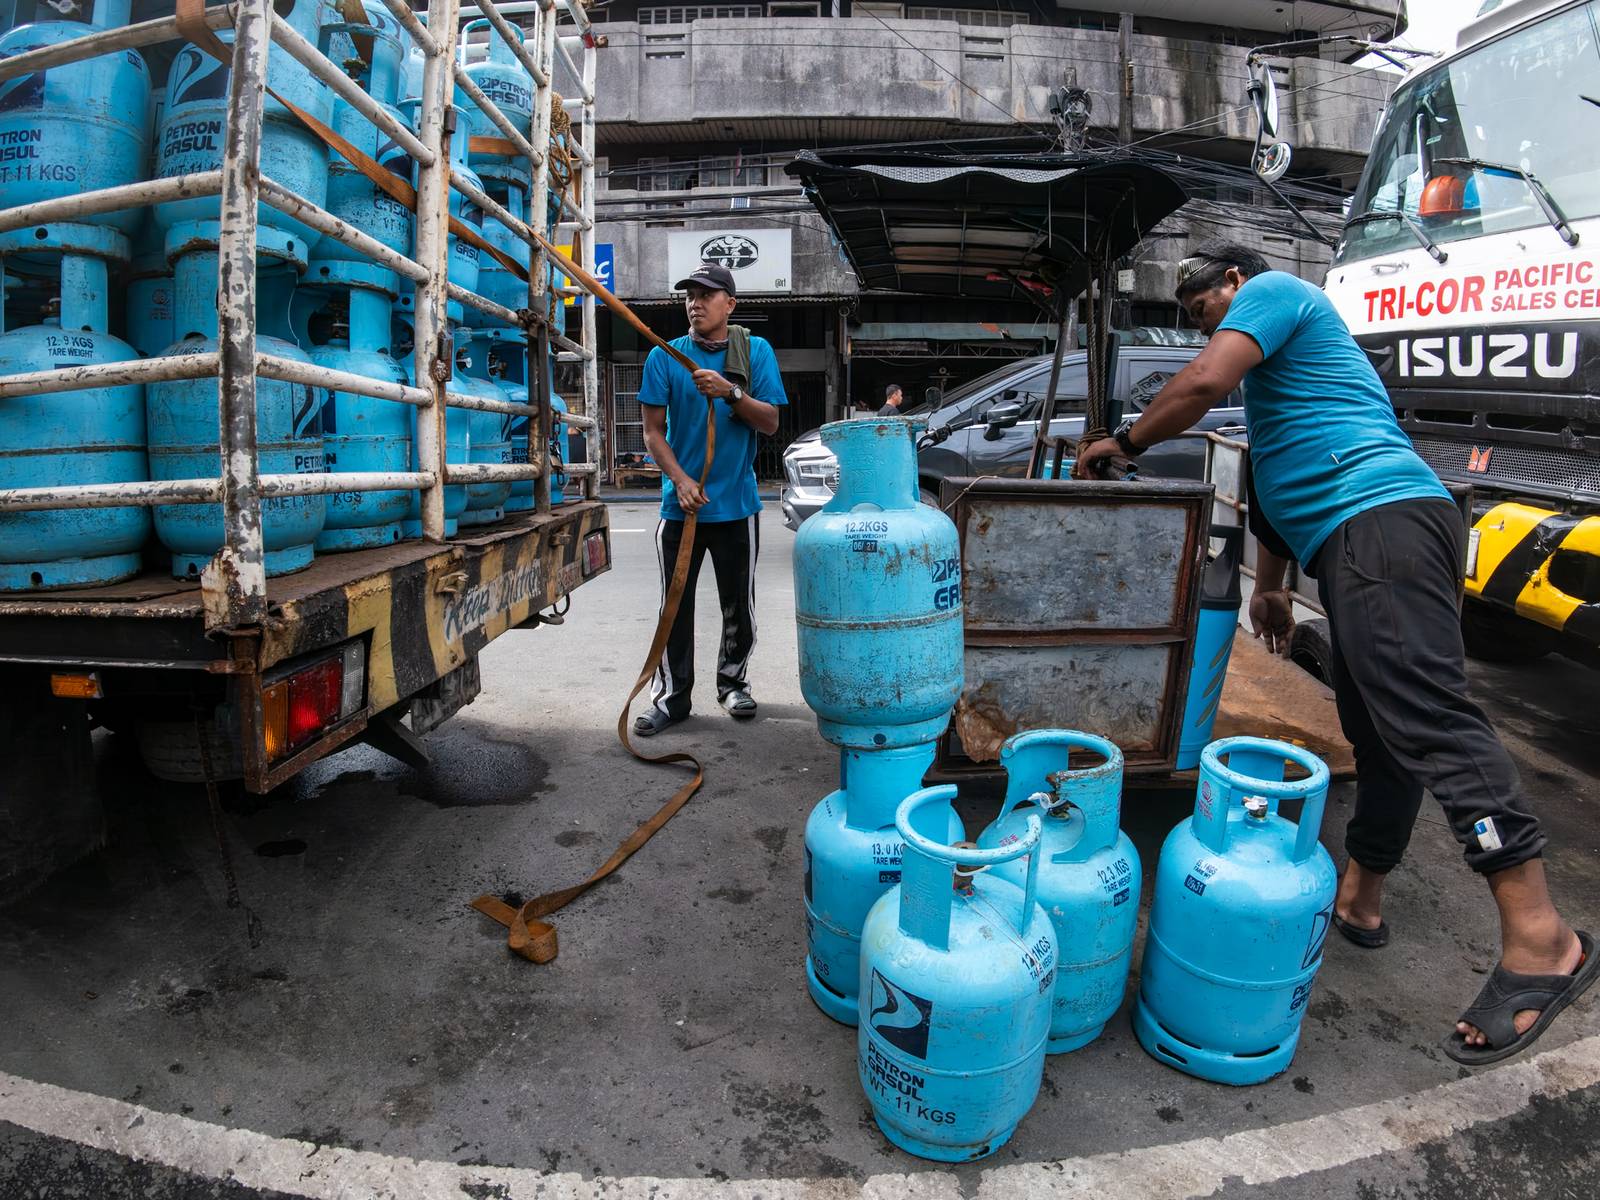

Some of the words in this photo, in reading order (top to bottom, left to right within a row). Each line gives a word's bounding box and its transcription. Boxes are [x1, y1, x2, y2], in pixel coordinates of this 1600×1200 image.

[166, 121, 222, 143] PETRON
[164, 135, 218, 160] GASUL
[40, 164, 77, 182] KGS
[1494, 261, 1594, 291] PACIFIC
[1364, 275, 1486, 323] TRI-COR
[1491, 291, 1557, 313] SALES
[48, 347, 67, 357] TARE
[67, 348, 94, 359] WEIGHT
[1398, 332, 1578, 378] ISUZU
[873, 856, 888, 865] TARE
[868, 1040, 926, 1089] PETRON
[867, 1055, 924, 1102] GASUL
[896, 1096, 911, 1114] 11
[917, 1105, 957, 1125] KGS
